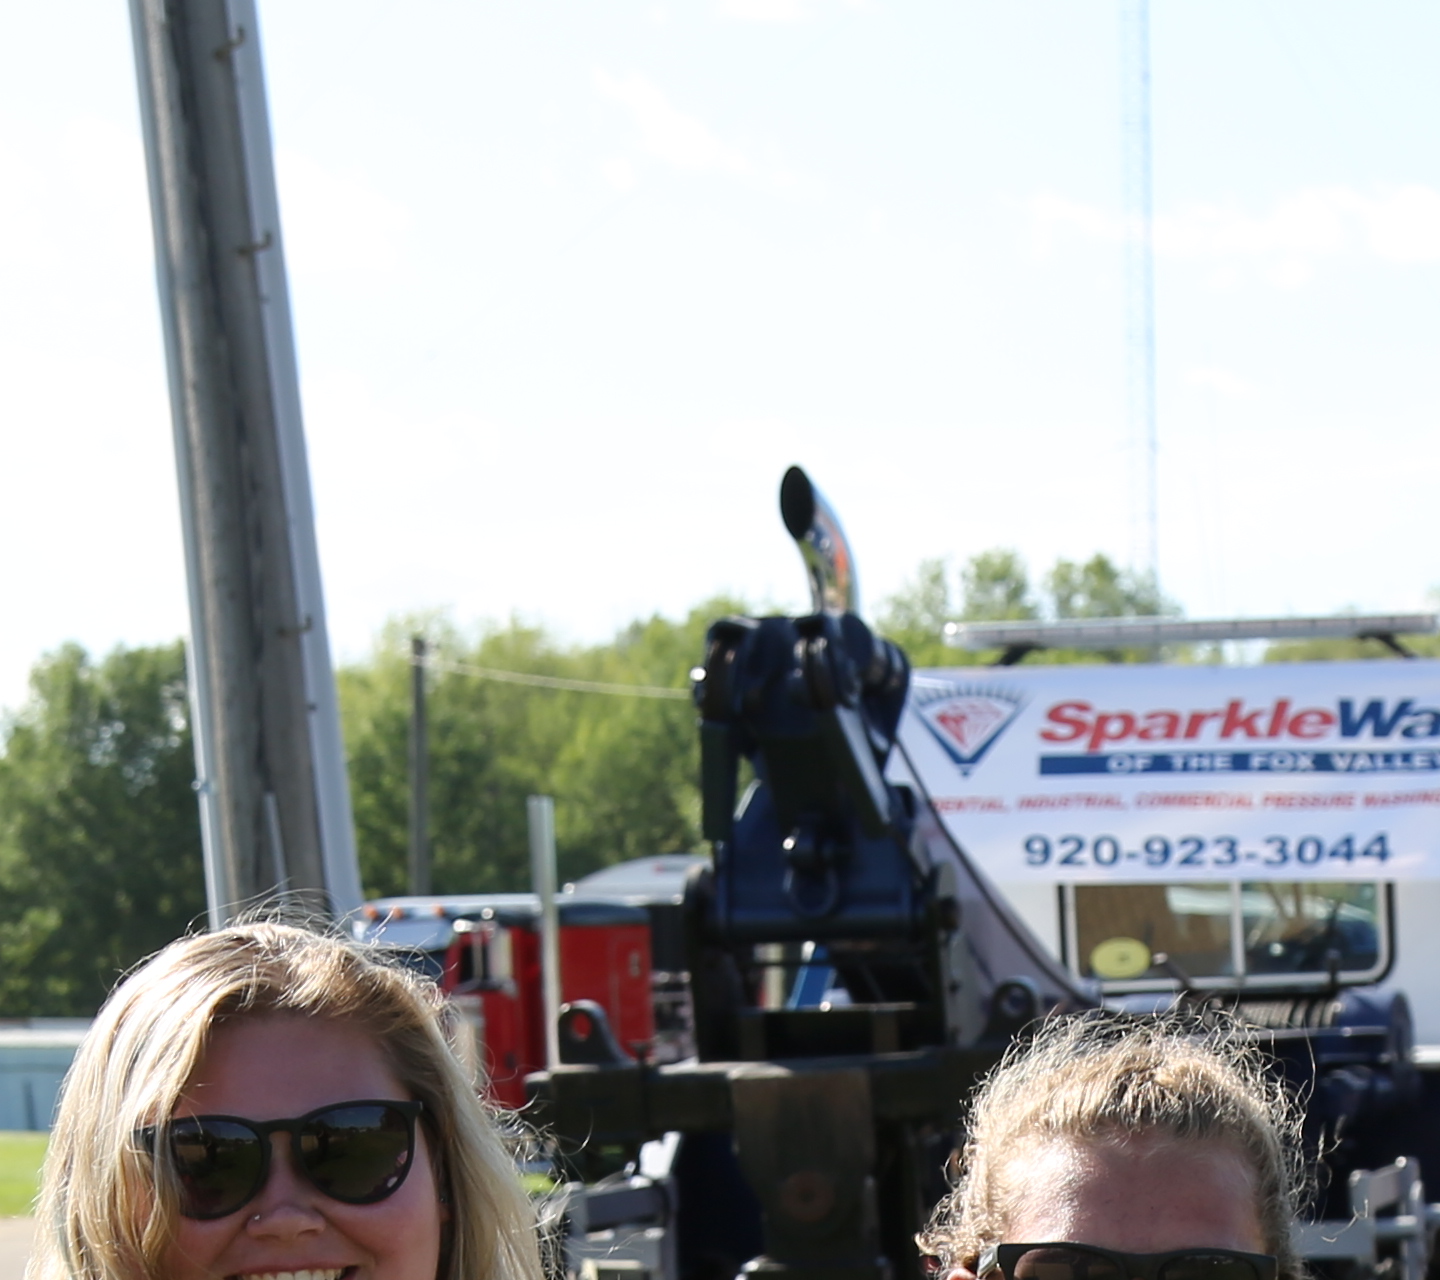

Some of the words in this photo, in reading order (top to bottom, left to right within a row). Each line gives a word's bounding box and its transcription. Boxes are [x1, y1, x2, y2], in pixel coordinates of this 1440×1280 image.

[1107, 755, 1152, 774] OF
[1170, 754, 1232, 772] THE
[1249, 752, 1315, 771] FOX
[1023, 831, 1390, 868] 920-923-3044
